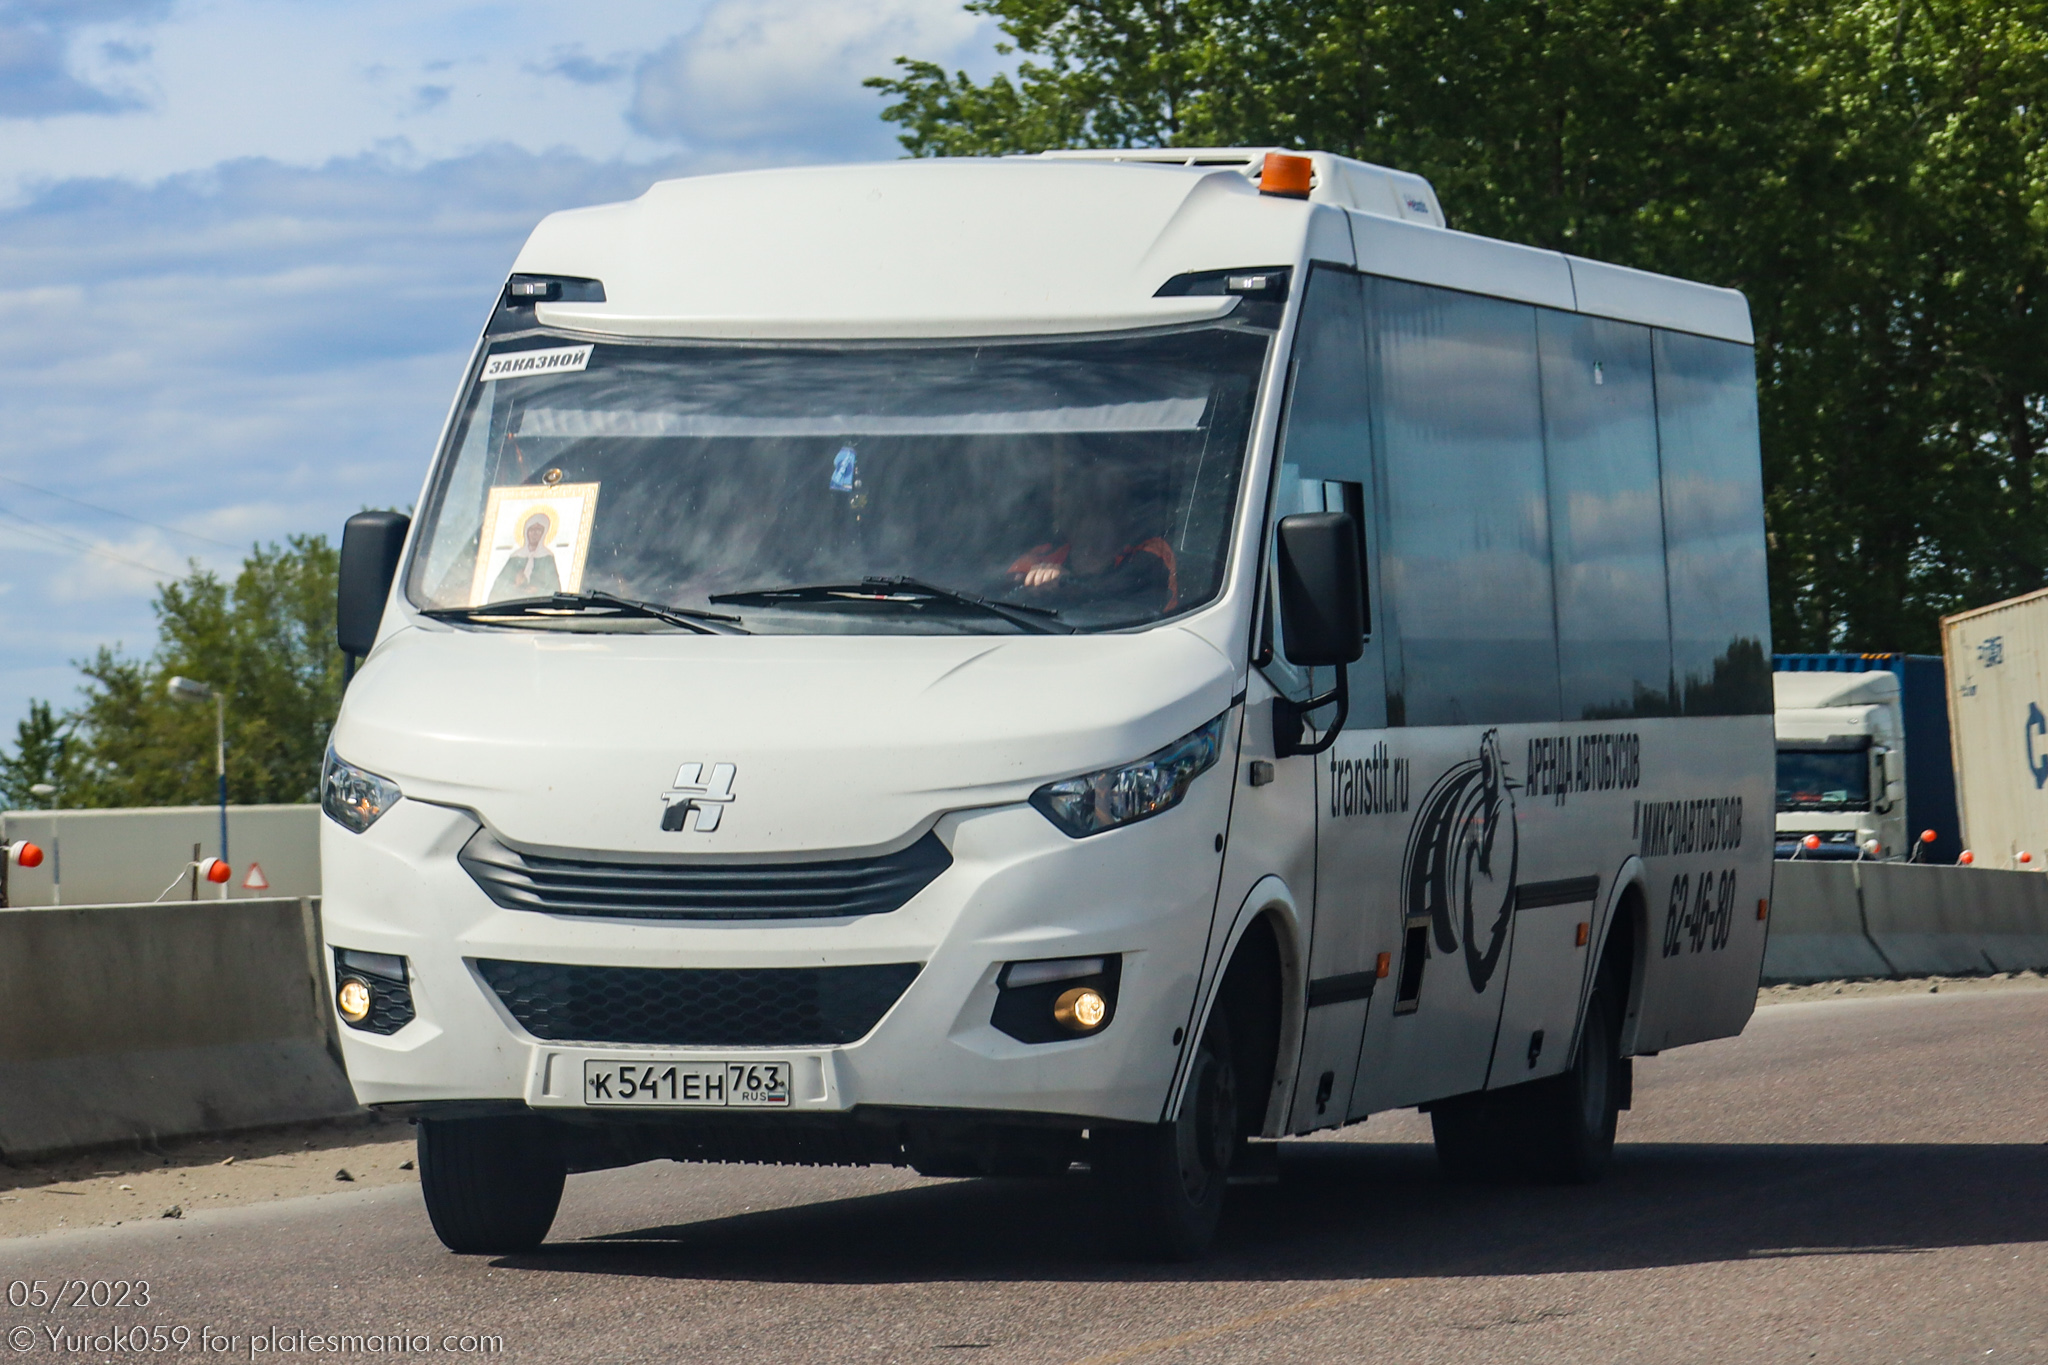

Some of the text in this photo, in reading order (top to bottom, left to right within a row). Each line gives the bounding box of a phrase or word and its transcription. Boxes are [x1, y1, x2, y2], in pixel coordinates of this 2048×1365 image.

[488, 349, 586, 375] ЗАКАЗНОЙ
[1330, 740, 1410, 818] transtlt.ru
[1525, 731, 1640, 808] АРЕНДА АВТОБУСОВ
[1640, 796, 1743, 859] МИКРОАВТОБУСОВ
[1662, 868, 1737, 960] 62-46-80
[742, 1091, 768, 1102] RUS
